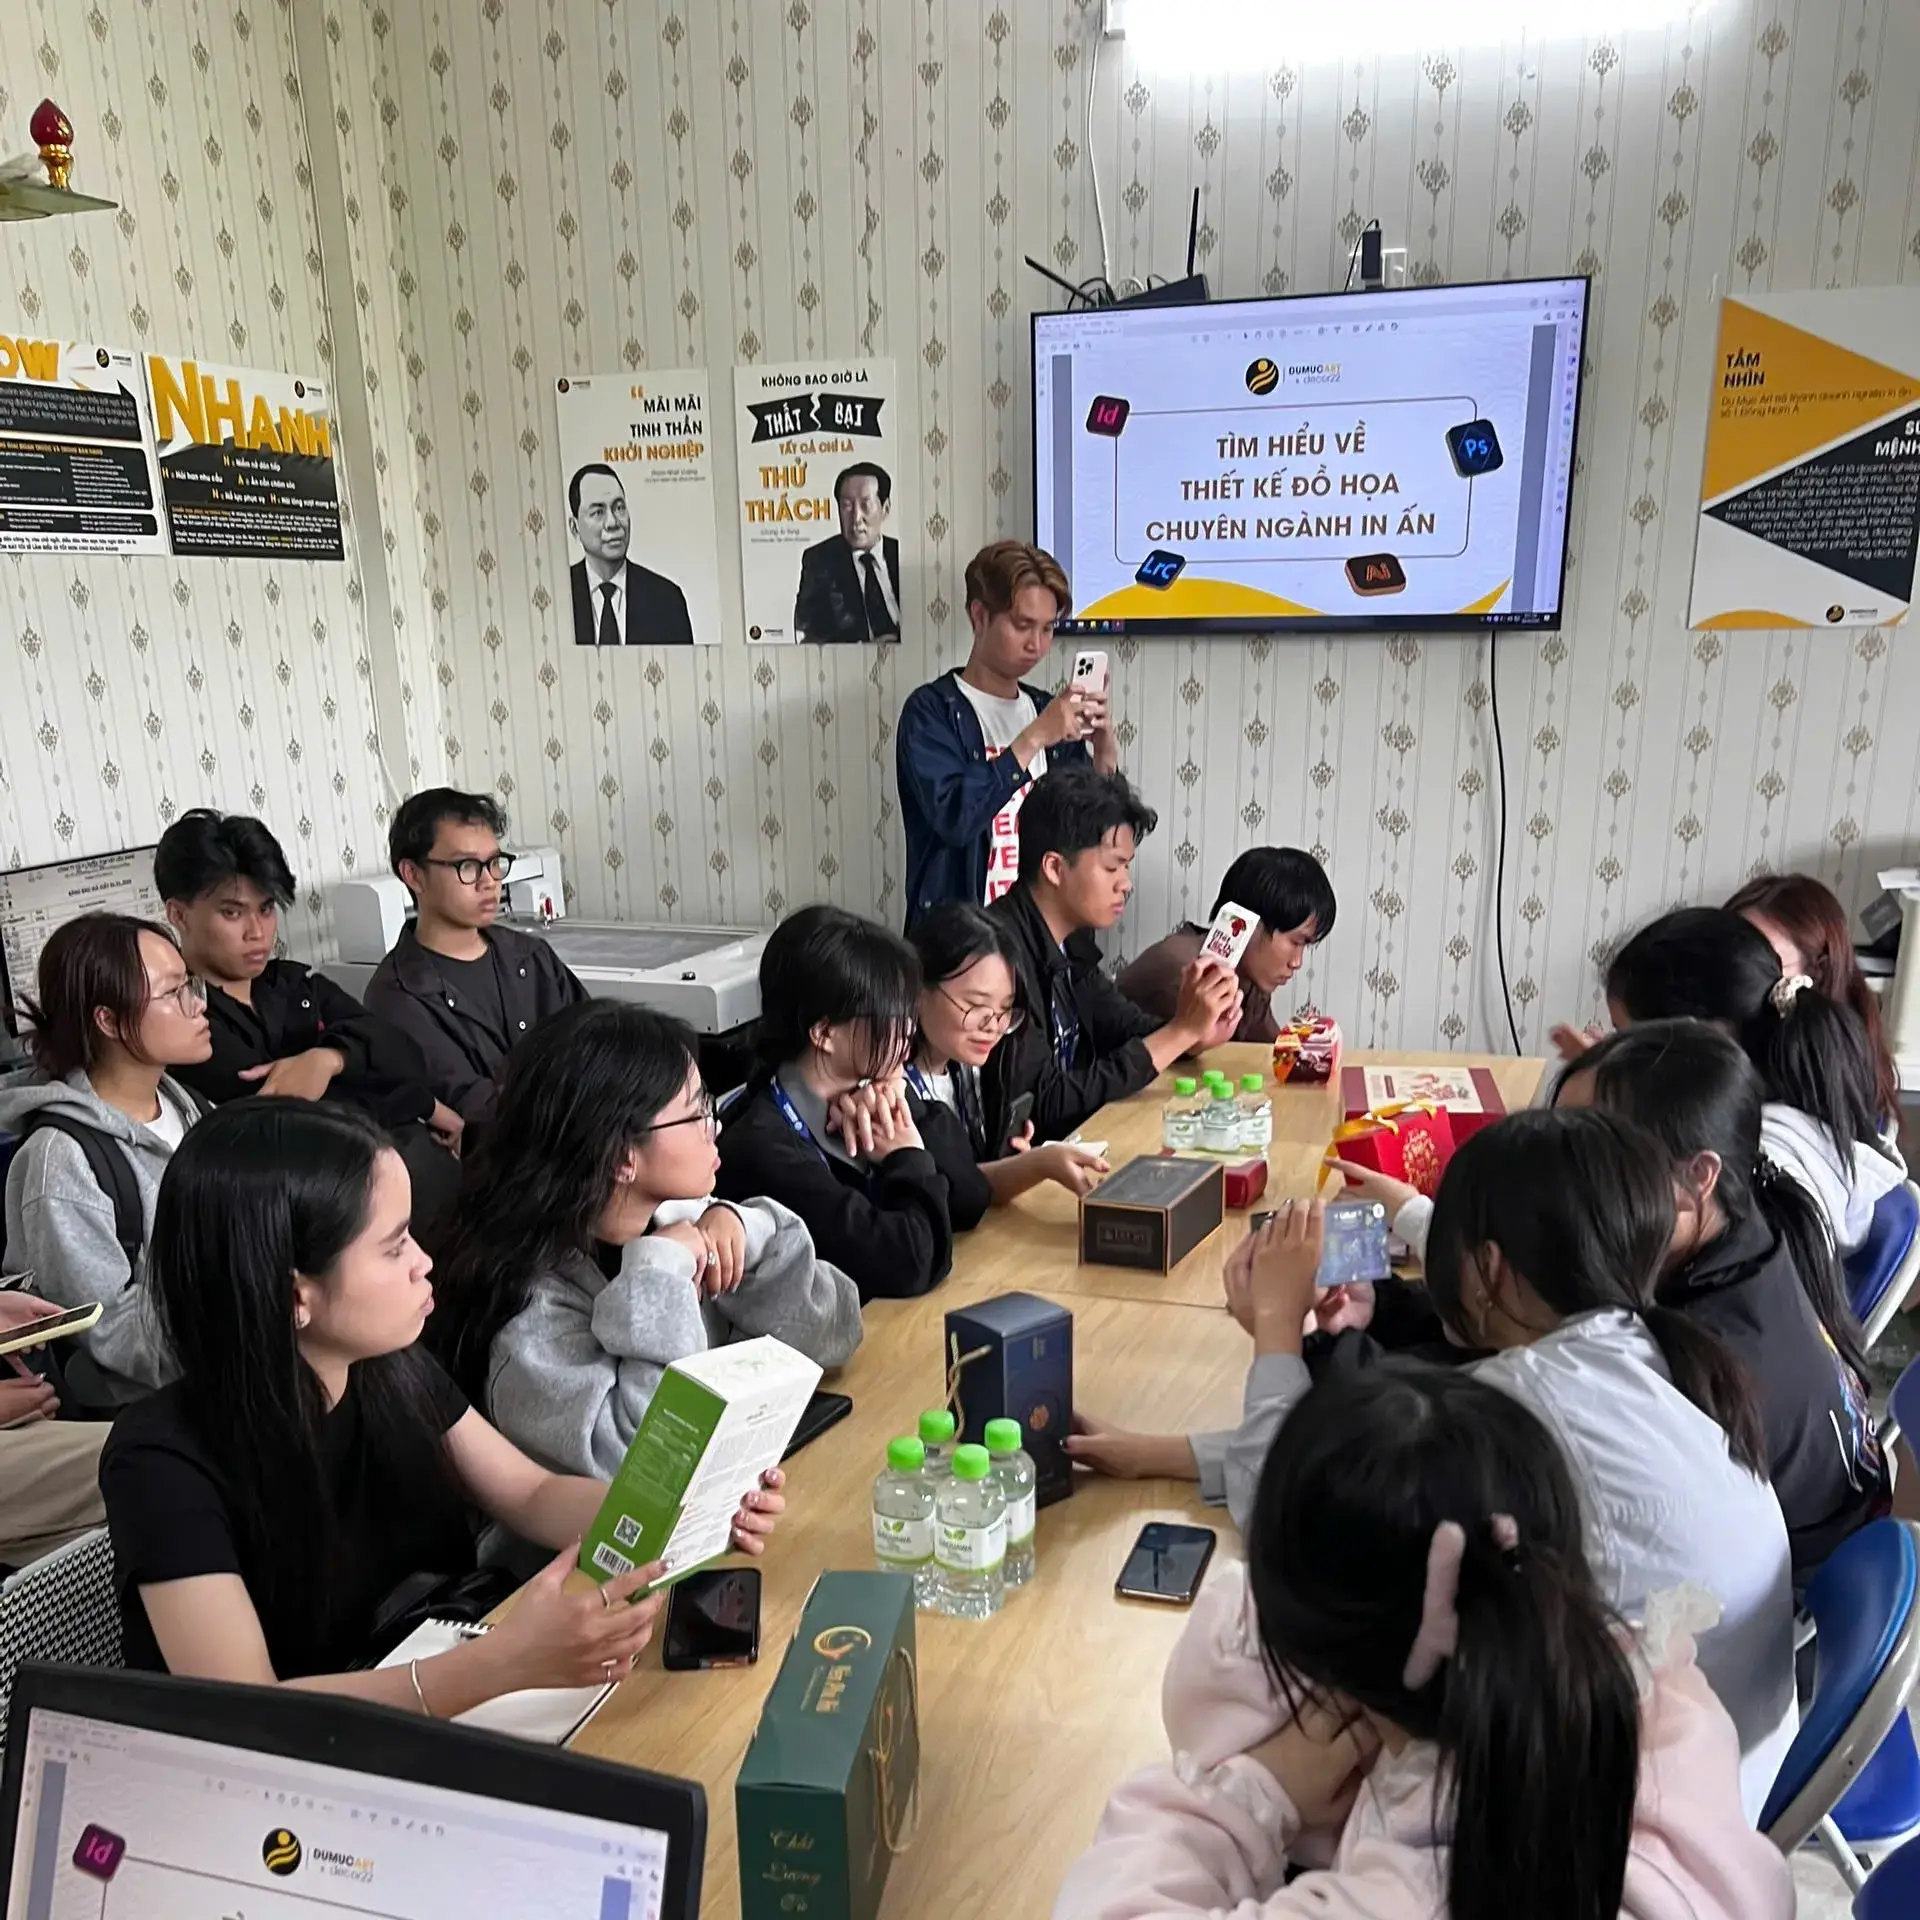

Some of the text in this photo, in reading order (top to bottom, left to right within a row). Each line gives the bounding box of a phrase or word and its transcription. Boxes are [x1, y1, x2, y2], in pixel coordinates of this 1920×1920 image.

[1726, 347, 1761, 369] TẦM
[761, 368, 869, 388] KHÔNG BAO GIỜ LÀ
[1724, 368, 1765, 388] NHÌN
[148, 355, 331, 459] NHANH
[644, 395, 701, 414] MÃI MÃI
[1096, 403, 1120, 426] Id
[630, 414, 703, 438] TINH THẦN
[765, 402, 864, 437] THẤT BẠI
[604, 440, 705, 463] KHỞI NGHIỆP
[779, 441, 798, 456] TẤT
[841, 438, 854, 453] LÀ
[1217, 420, 1367, 459] TÌM HIỂU VỀ
[1465, 438, 1488, 459] Ps
[759, 457, 808, 490] THỬ
[1181, 464, 1400, 501] THIẾT KẾ ĐỒ HỌA
[745, 489, 831, 523] THÁCH
[1146, 503, 1436, 542] CHUYÊN NGÀNH IN ẤN
[86, 1835, 114, 1865] Id
